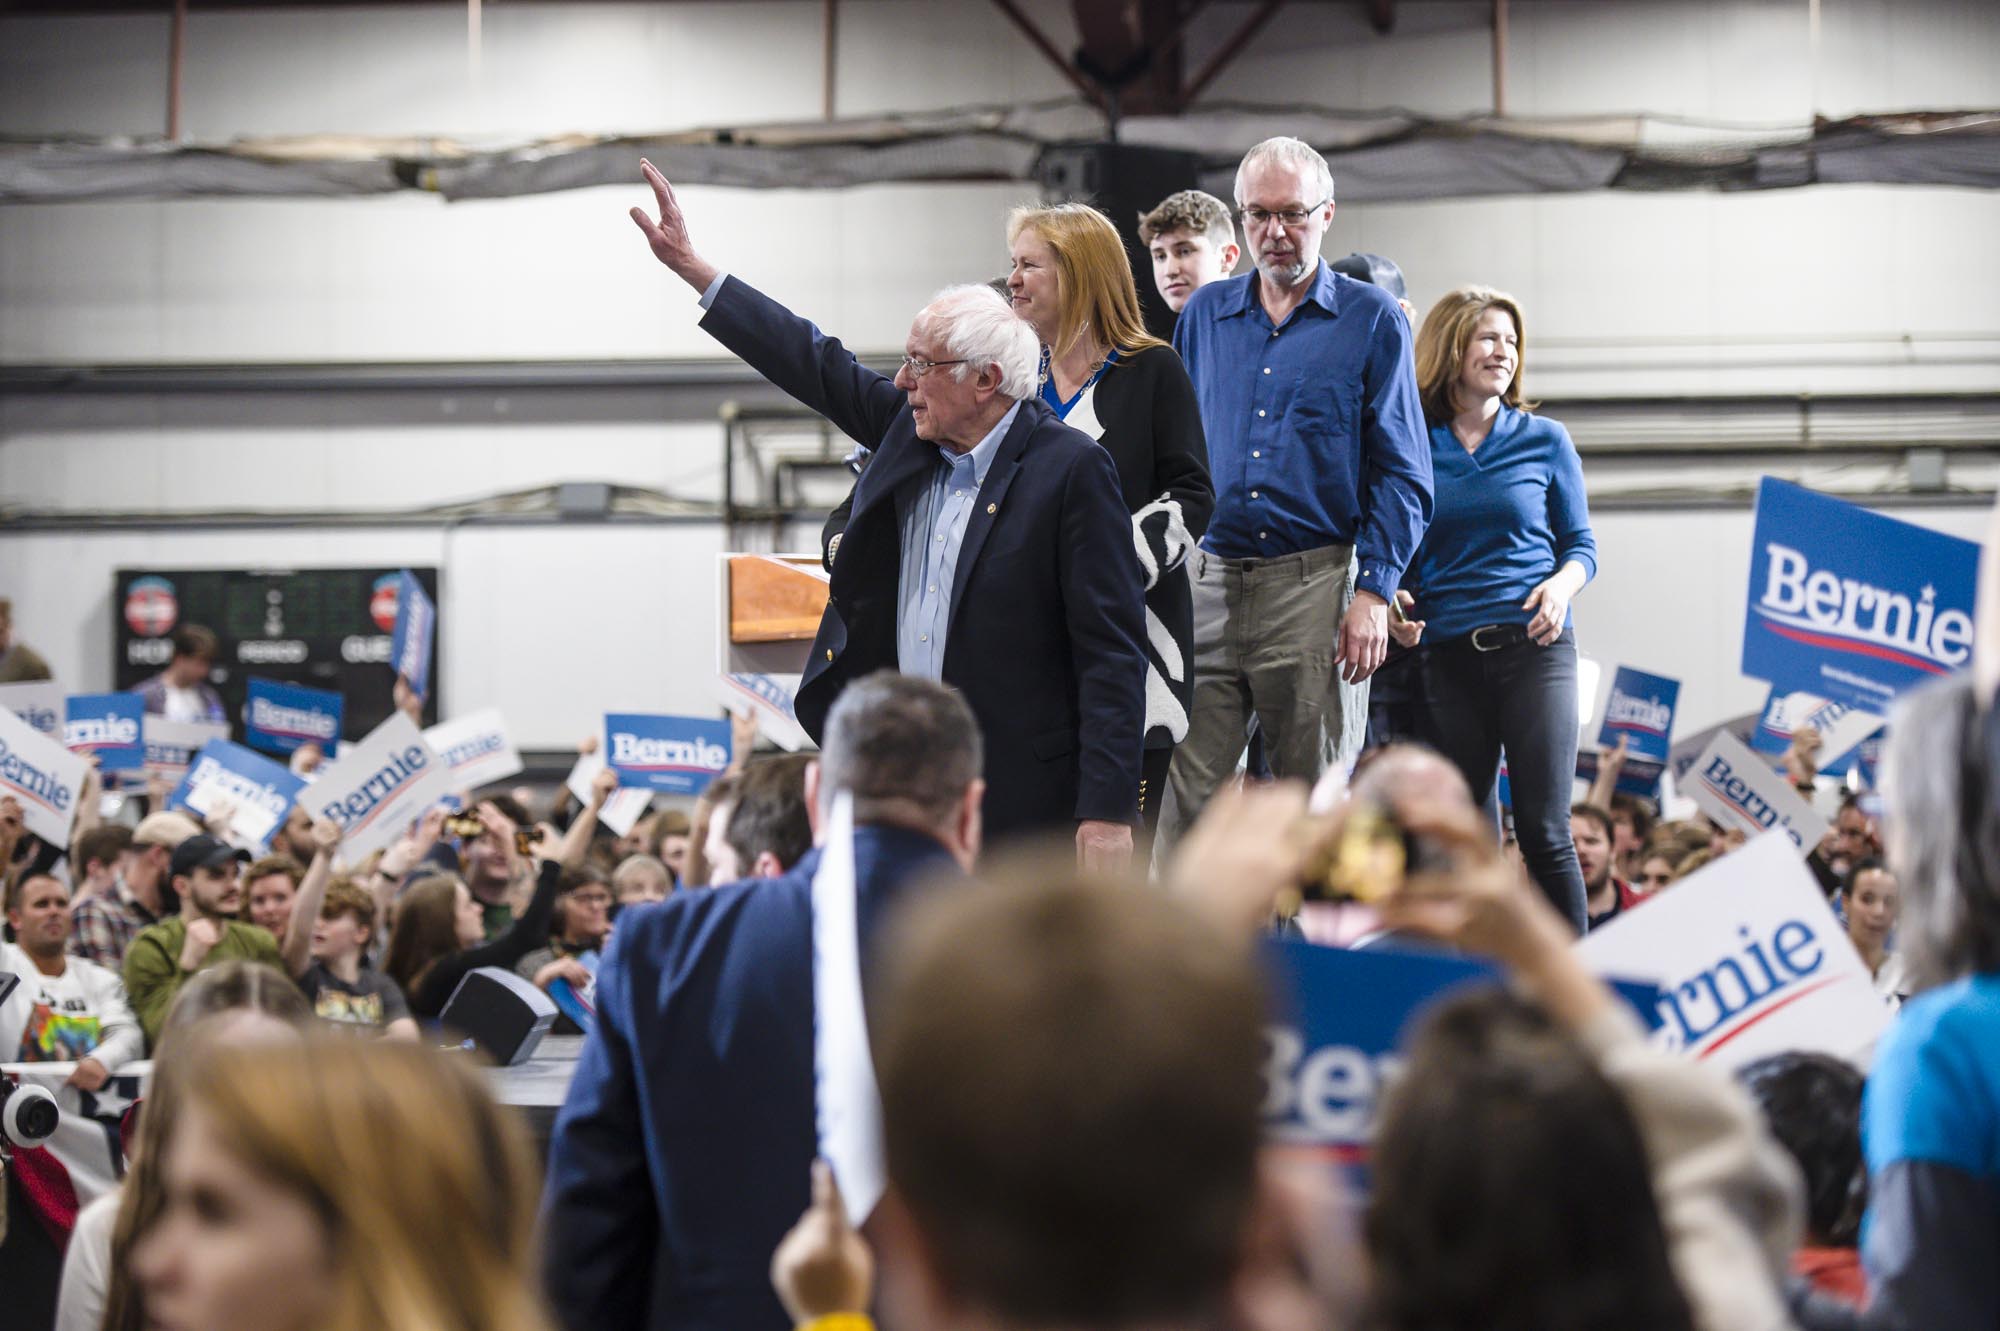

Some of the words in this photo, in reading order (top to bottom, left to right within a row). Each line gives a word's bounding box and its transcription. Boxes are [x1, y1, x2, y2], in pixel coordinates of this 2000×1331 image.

[1761, 543, 1974, 666] Bernie
[253, 699, 338, 741] Bernie
[611, 732, 728, 770] Bernie
[1658, 919, 1824, 1046] rnie
